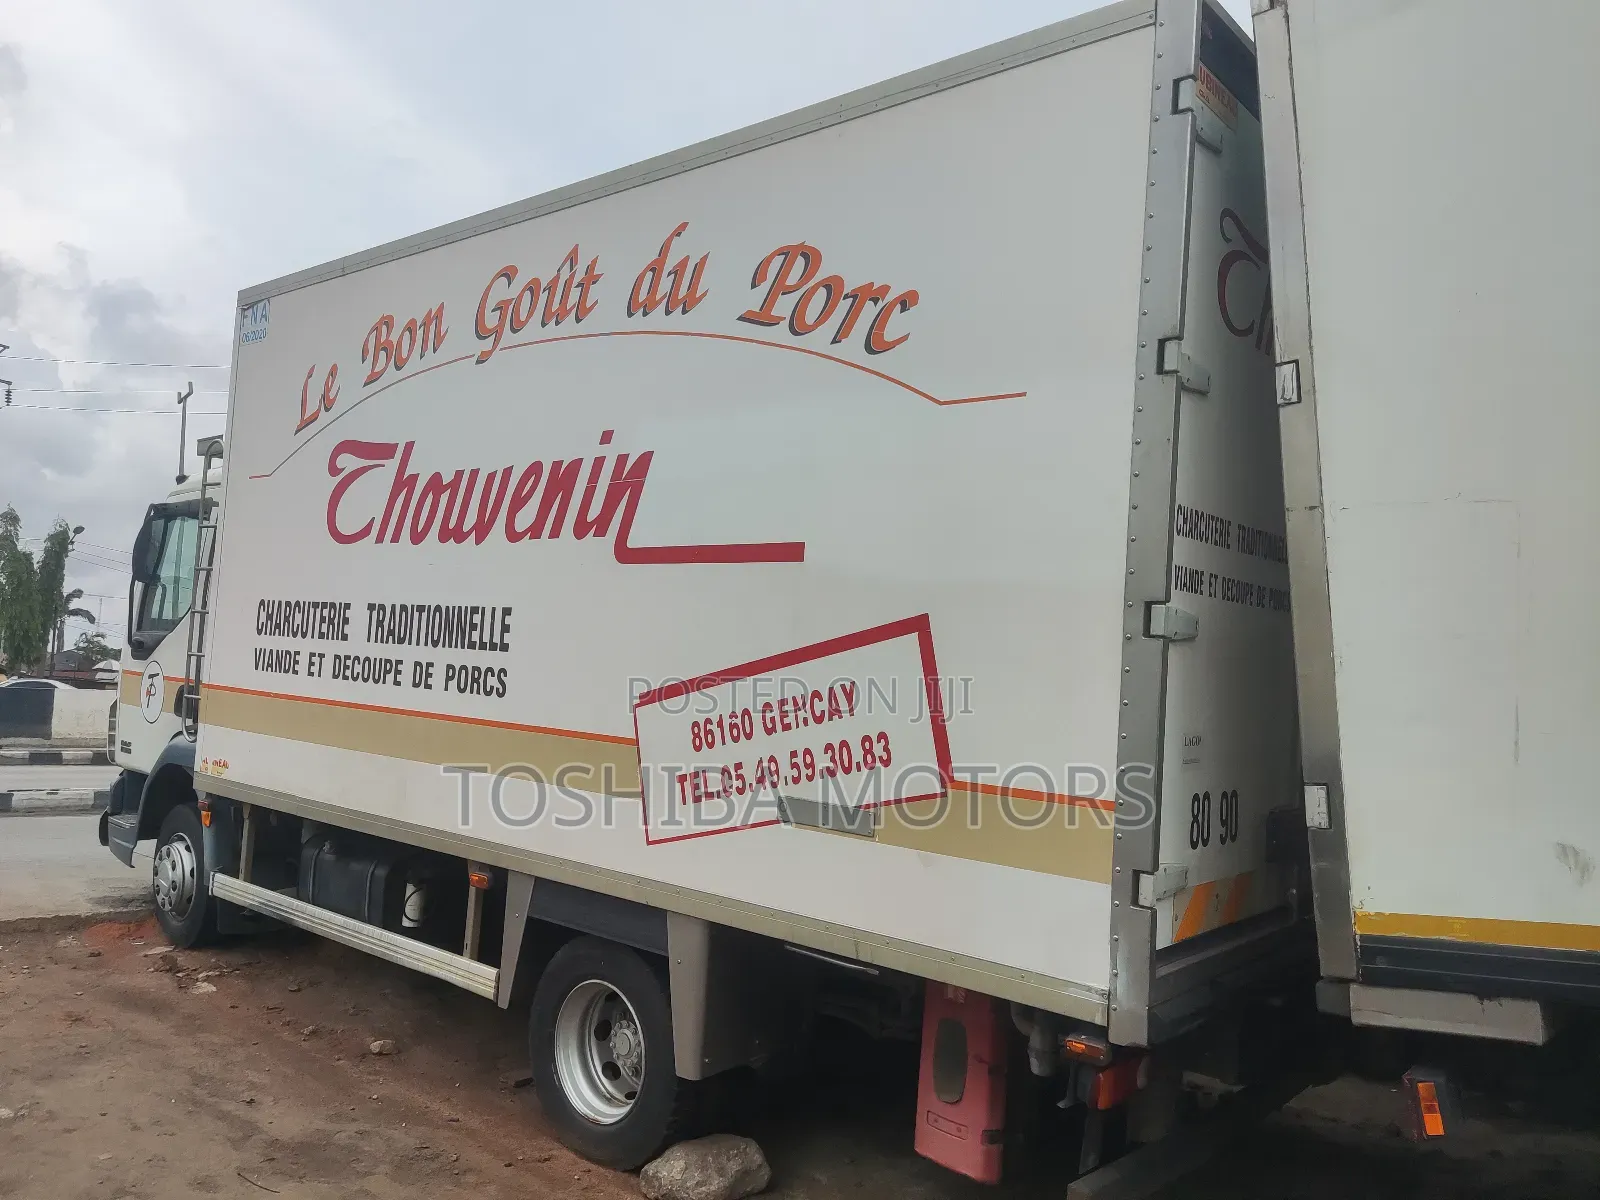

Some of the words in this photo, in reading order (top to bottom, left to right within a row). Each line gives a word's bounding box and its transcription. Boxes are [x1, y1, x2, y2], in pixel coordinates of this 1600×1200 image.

[293, 363, 341, 437] Le
[362, 301, 449, 388] Bon
[474, 243, 604, 365] Goût
[626, 221, 710, 319] du
[736, 240, 919, 355] Porc
[327, 429, 805, 564] Thouvenin
[1175, 503, 1232, 550] CHARCUTERIE
[1174, 564, 1205, 596] VIANDE
[1208, 572, 1219, 599] ET
[1221, 576, 1254, 607] DECOUPE
[256, 598, 351, 641] CHARCUTERIE
[366, 603, 512, 653] TRADITIONNELLE
[254, 647, 301, 676] VIANDE
[307, 651, 325, 678] ET
[332, 654, 404, 687] DECOUPE
[412, 660, 435, 690] DE
[443, 663, 508, 698] PORCS
[691, 707, 754, 753] 86160
[761, 681, 856, 737] GENCAY
[1190, 792, 1211, 850] 80
[1219, 789, 1239, 846] 90
